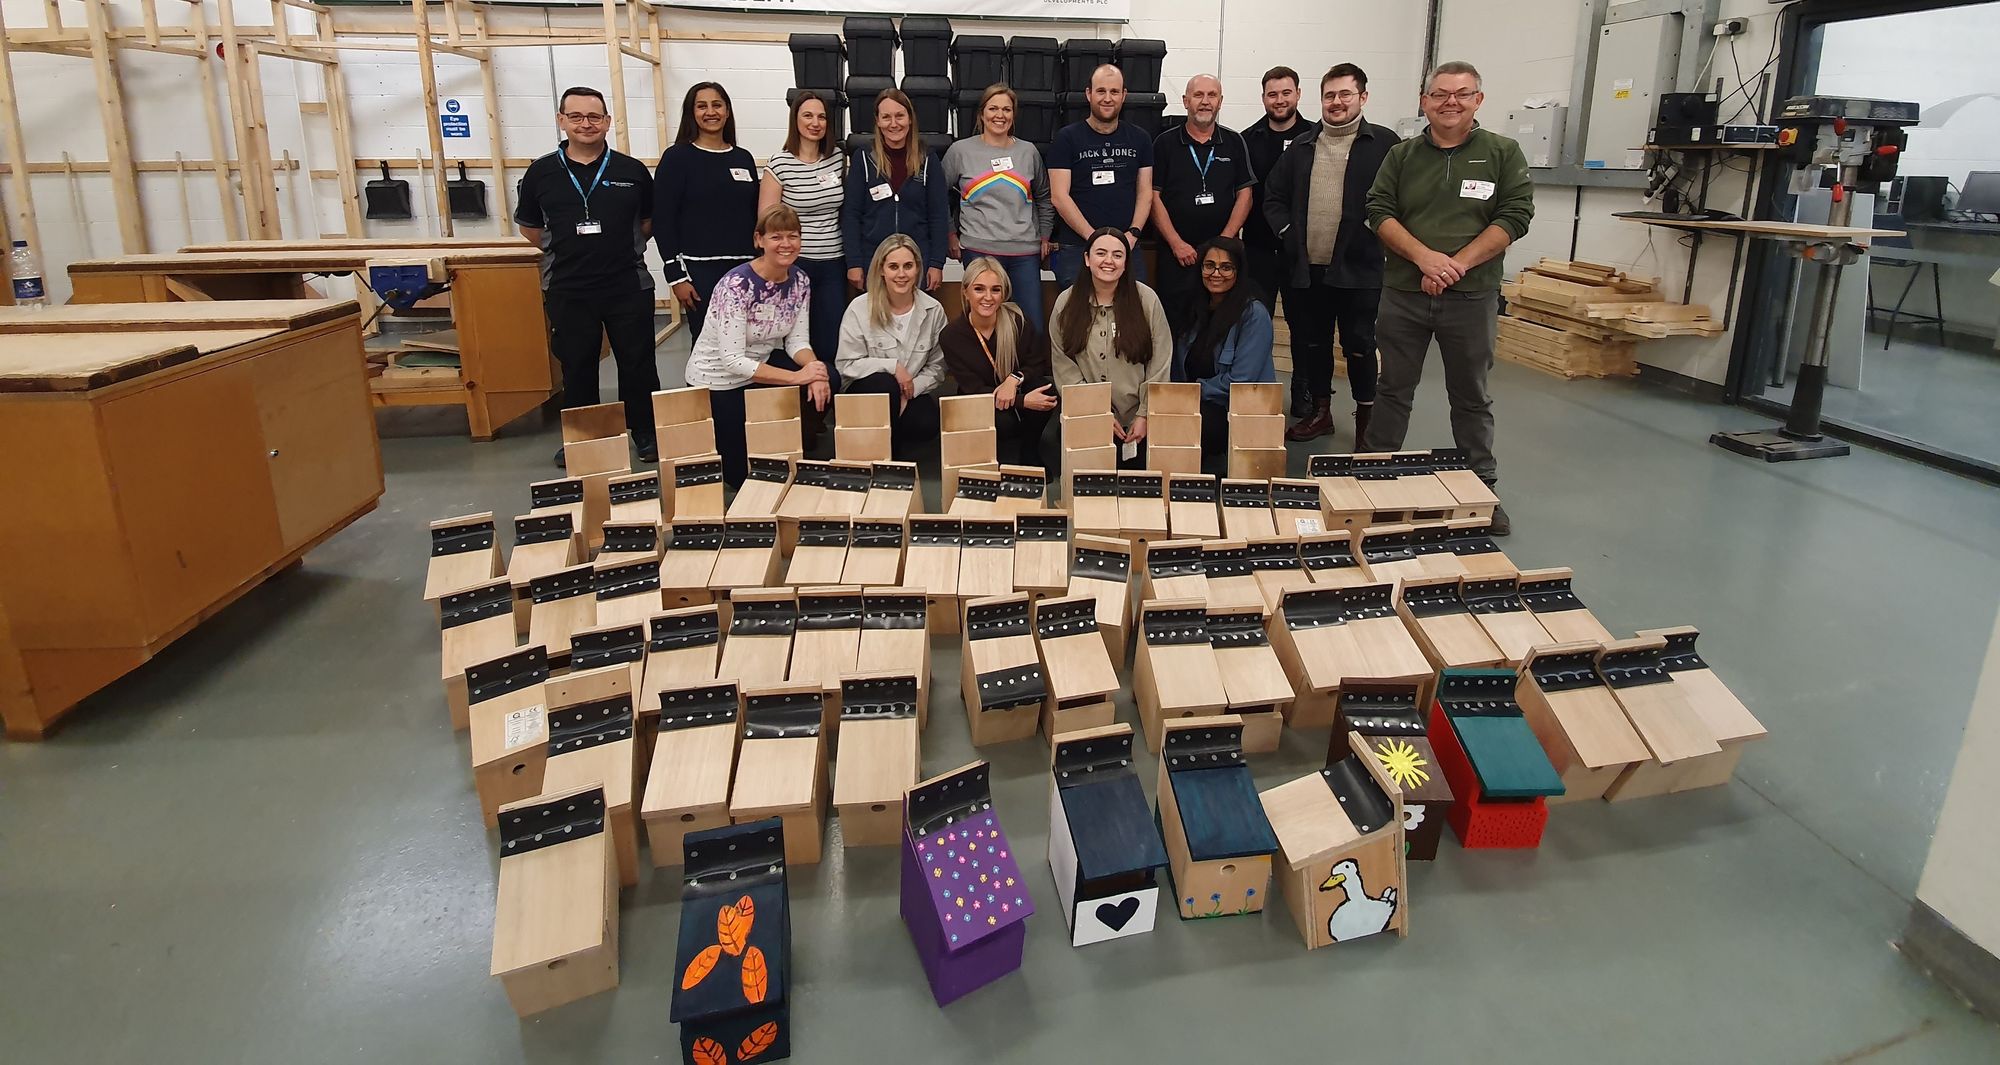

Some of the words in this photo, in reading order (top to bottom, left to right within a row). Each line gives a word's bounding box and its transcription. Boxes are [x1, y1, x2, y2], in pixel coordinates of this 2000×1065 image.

[1079, 149, 1100, 160] JACK
[1102, 148, 1108, 157] &
[1111, 148, 1137, 158] JONES
